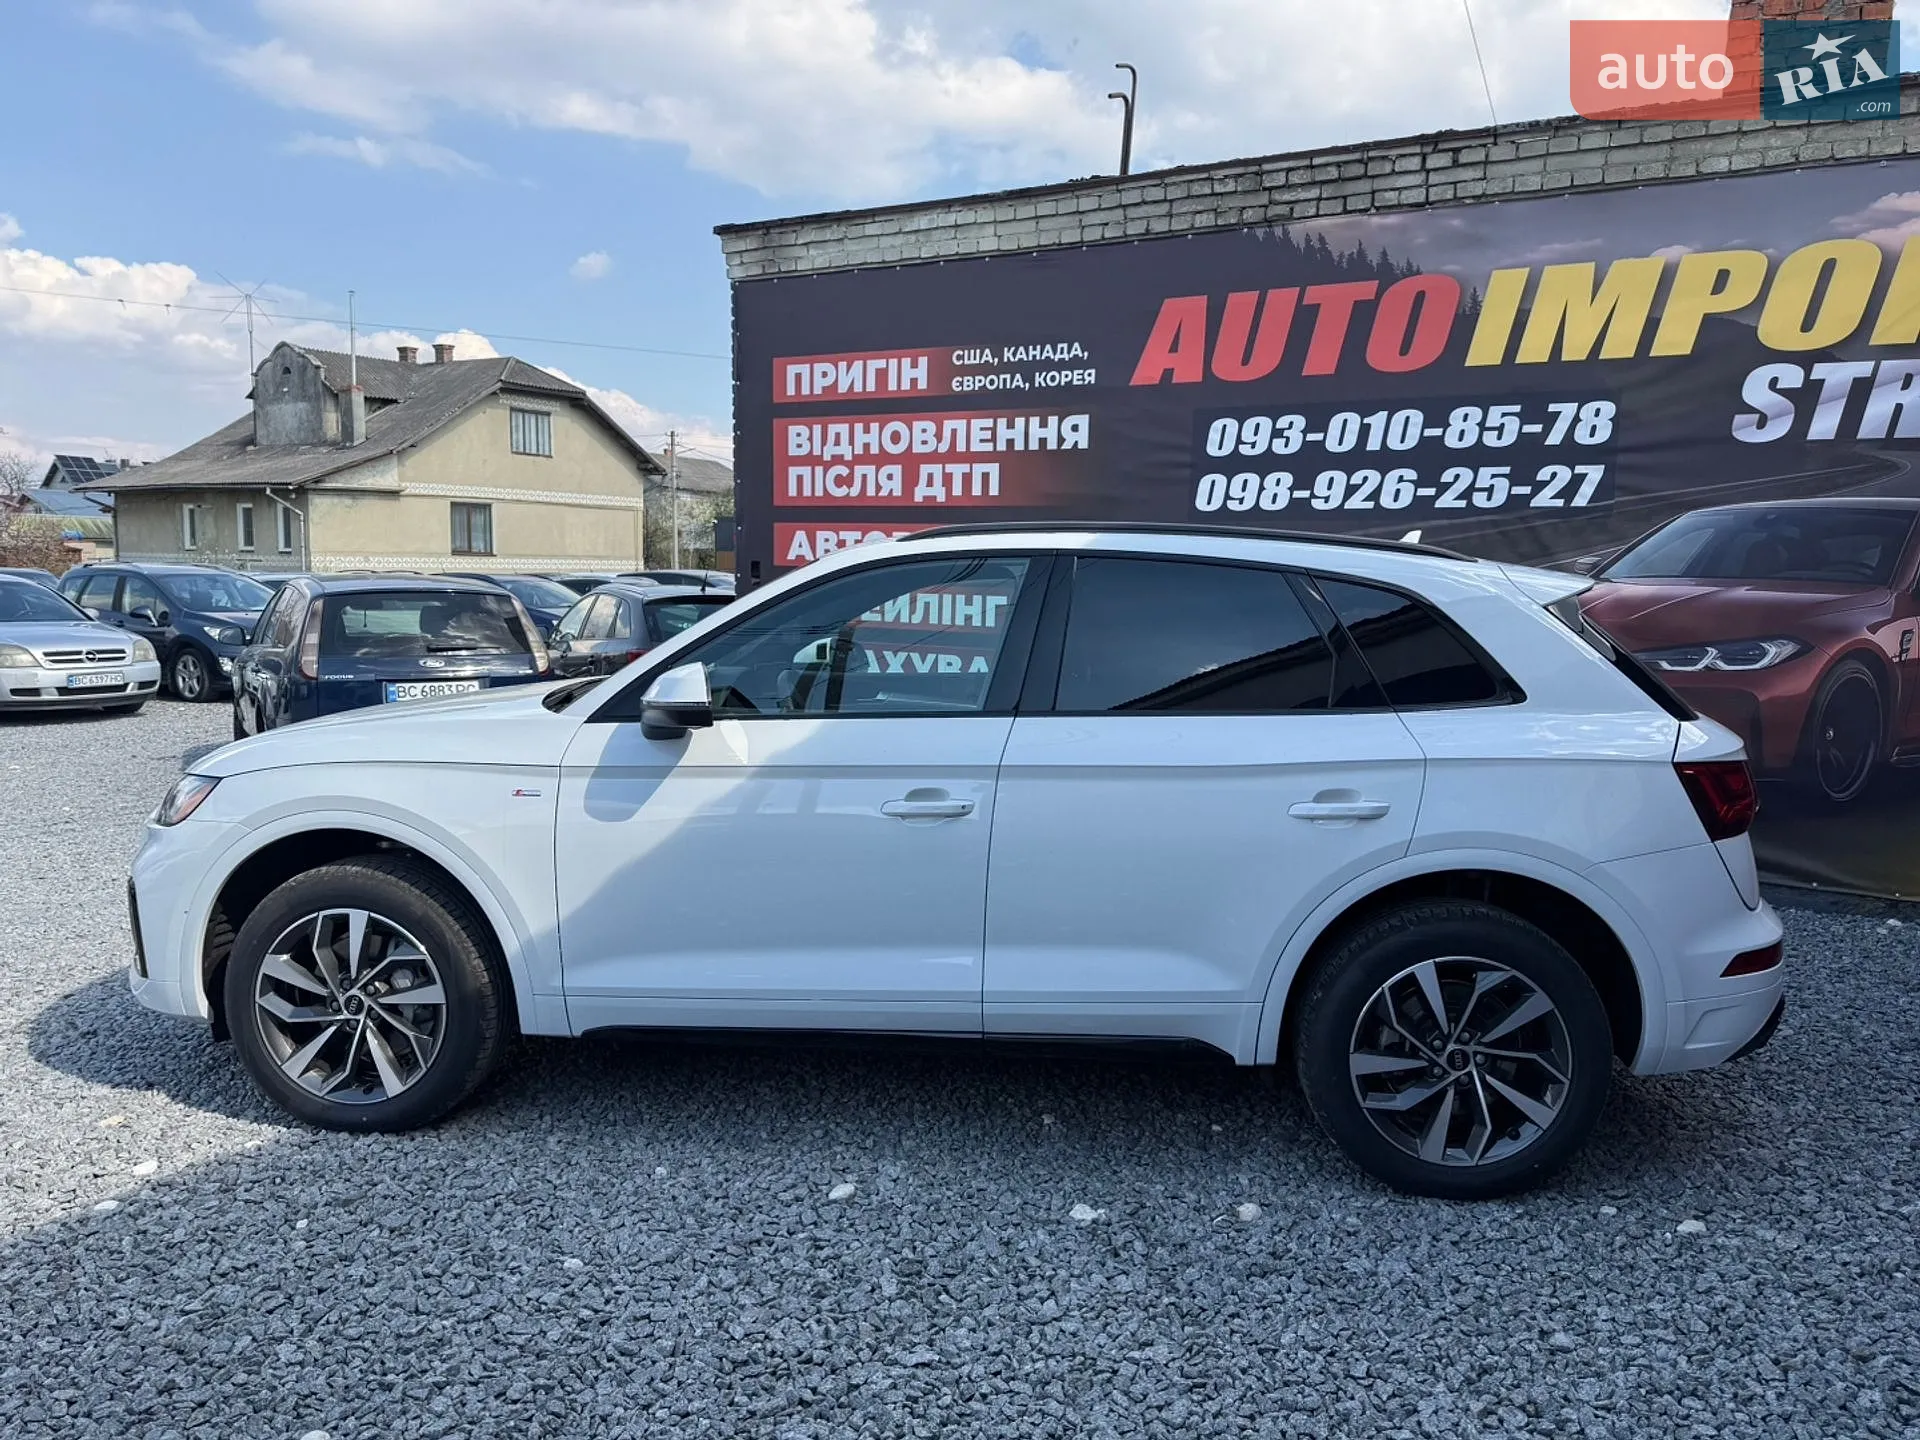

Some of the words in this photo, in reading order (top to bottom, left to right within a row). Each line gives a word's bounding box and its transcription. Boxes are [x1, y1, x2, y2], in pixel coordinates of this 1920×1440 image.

[952, 348, 999, 366] США,
[1003, 341, 1089, 363] КАНАДА,
[786, 356, 929, 396] ПРИГІН
[951, 373, 1030, 392] ЄВРОПА,
[1034, 368, 1097, 387] КОРЕЯ
[788, 414, 1090, 461] ВІДНОВЛЕННЯ
[1206, 400, 1617, 457] 093-010-85-78
[788, 464, 903, 498] ПІСЛЯ
[914, 462, 1000, 502] ДТП
[1194, 464, 1606, 512] 098-926-25-27
